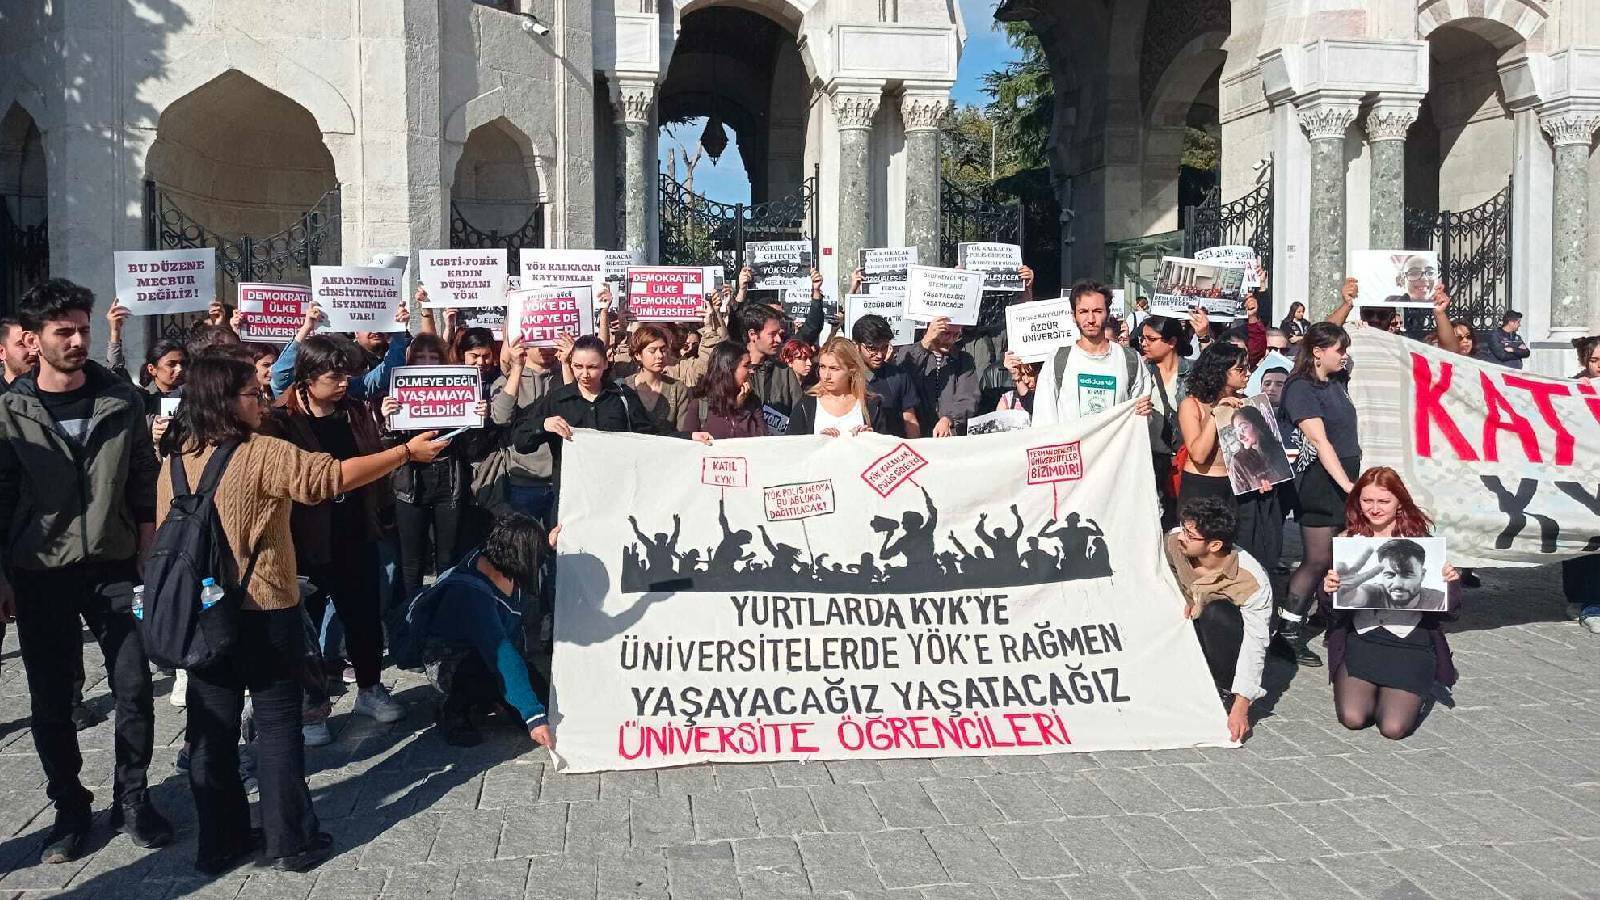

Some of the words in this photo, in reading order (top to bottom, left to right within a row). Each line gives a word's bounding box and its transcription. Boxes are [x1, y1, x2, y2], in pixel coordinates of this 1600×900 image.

[128, 263, 148, 273] BU
[150, 260, 205, 273] DÜZENE
[526, 261, 547, 271] YÖK
[548, 263, 601, 272] KALKACAK
[137, 275, 195, 287] MECBUR
[321, 276, 395, 286] AKADEMİDEKİ
[532, 274, 594, 282] KAYYUMLAR
[633, 273, 697, 282] DEMOKRATİK
[441, 280, 491, 290] DÜŞMANI
[652, 284, 679, 294] ÜLKE
[247, 291, 310, 302] DEMOKRATİ
[453, 290, 478, 299] YÖK!
[633, 295, 697, 305] DEMOKRATİK
[269, 301, 297, 313] ÜLKE
[332, 298, 387, 309] İSYANIMIZ
[559, 300, 575, 310] DE
[247, 314, 305, 325] DEMOKRAT
[562, 313, 579, 323] DE
[396, 376, 444, 387] ÖLMEYE
[445, 375, 477, 387] DEĞİL
[400, 389, 474, 405] YAŞAMAYA
[411, 402, 464, 416] GELDİK!
[730, 595, 906, 629] YURTLARDA
[910, 594, 1009, 625] KYK'YE
[620, 633, 899, 672] ÜNİVERSİTELERDE
[907, 628, 993, 665] YÖK'E
[1000, 621, 1122, 663] RAĞMEN
[631, 676, 883, 727] YAŞAYACAĞIZ
[891, 663, 1130, 717] YAŞATACAĞIZ
[619, 718, 819, 760] ÜNİVERSİTE
[838, 708, 1072, 750] ÖĞRENCİLERİ
